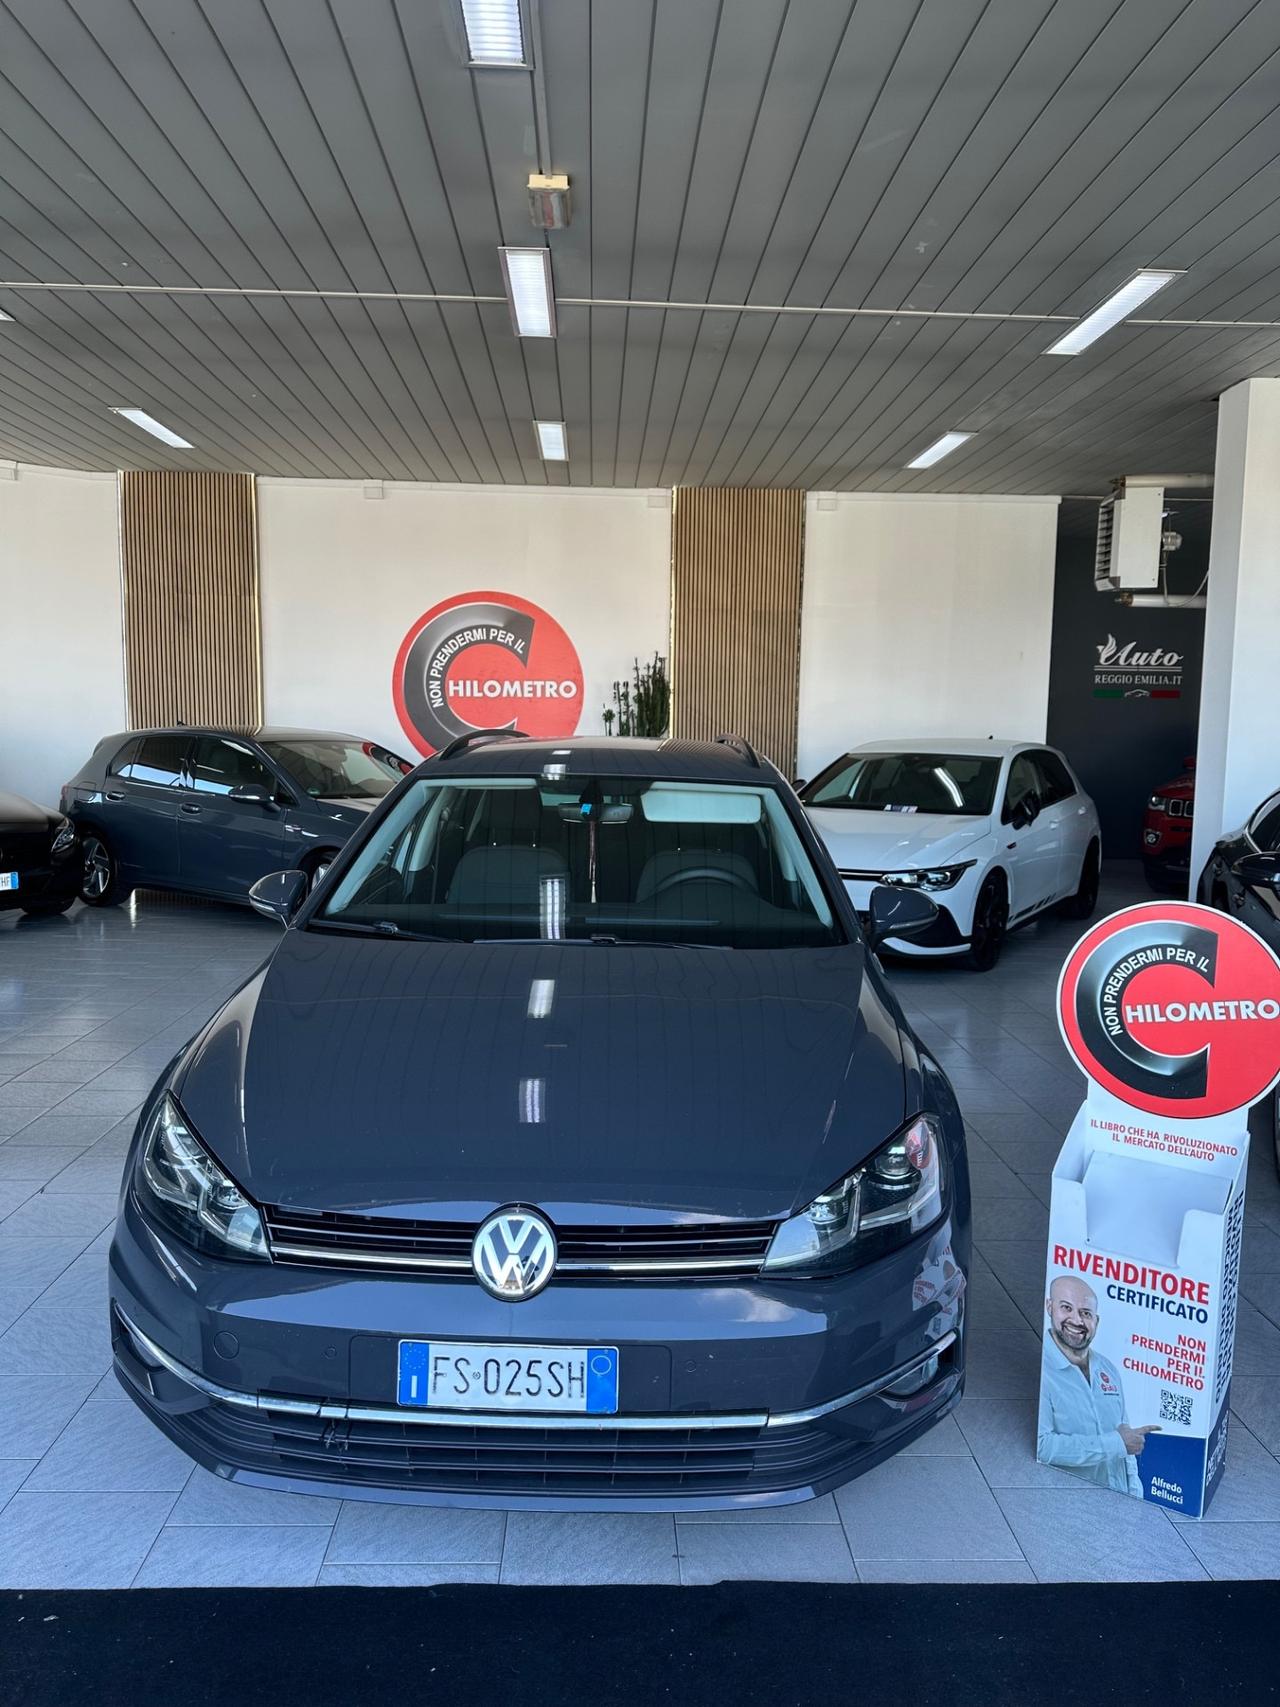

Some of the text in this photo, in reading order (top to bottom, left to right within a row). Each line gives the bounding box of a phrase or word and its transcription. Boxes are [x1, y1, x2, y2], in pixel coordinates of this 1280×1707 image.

[429, 628, 526, 708] NON PRENDERMI PER IL
[1095, 674, 1182, 685] REGGIO EMILIA.IT
[448, 680, 577, 698] HILOMETRO
[1104, 947, 1211, 1036] NON PRENDERMI PER IL
[1125, 999, 1280, 1023] HILOMETRO
[1091, 1119, 1238, 1156] IL LIBRO CHE HA RIVOLUZIONATO
[1112, 1133, 1215, 1161] IL MERCATO DELL'AUTO
[1053, 1244, 1210, 1305] RIVENDITORE
[1106, 1284, 1208, 1324] CERTIFICATO
[1132, 1334, 1206, 1365] PRENDERMI
[1178, 1334, 1206, 1352] NON
[1123, 1358, 1204, 1390] CHILOMETRO
[1167, 1358, 1190, 1374] PER
[1151, 1476, 1182, 1494] Alfredo
[1151, 1486, 1183, 1504] Bellucci
